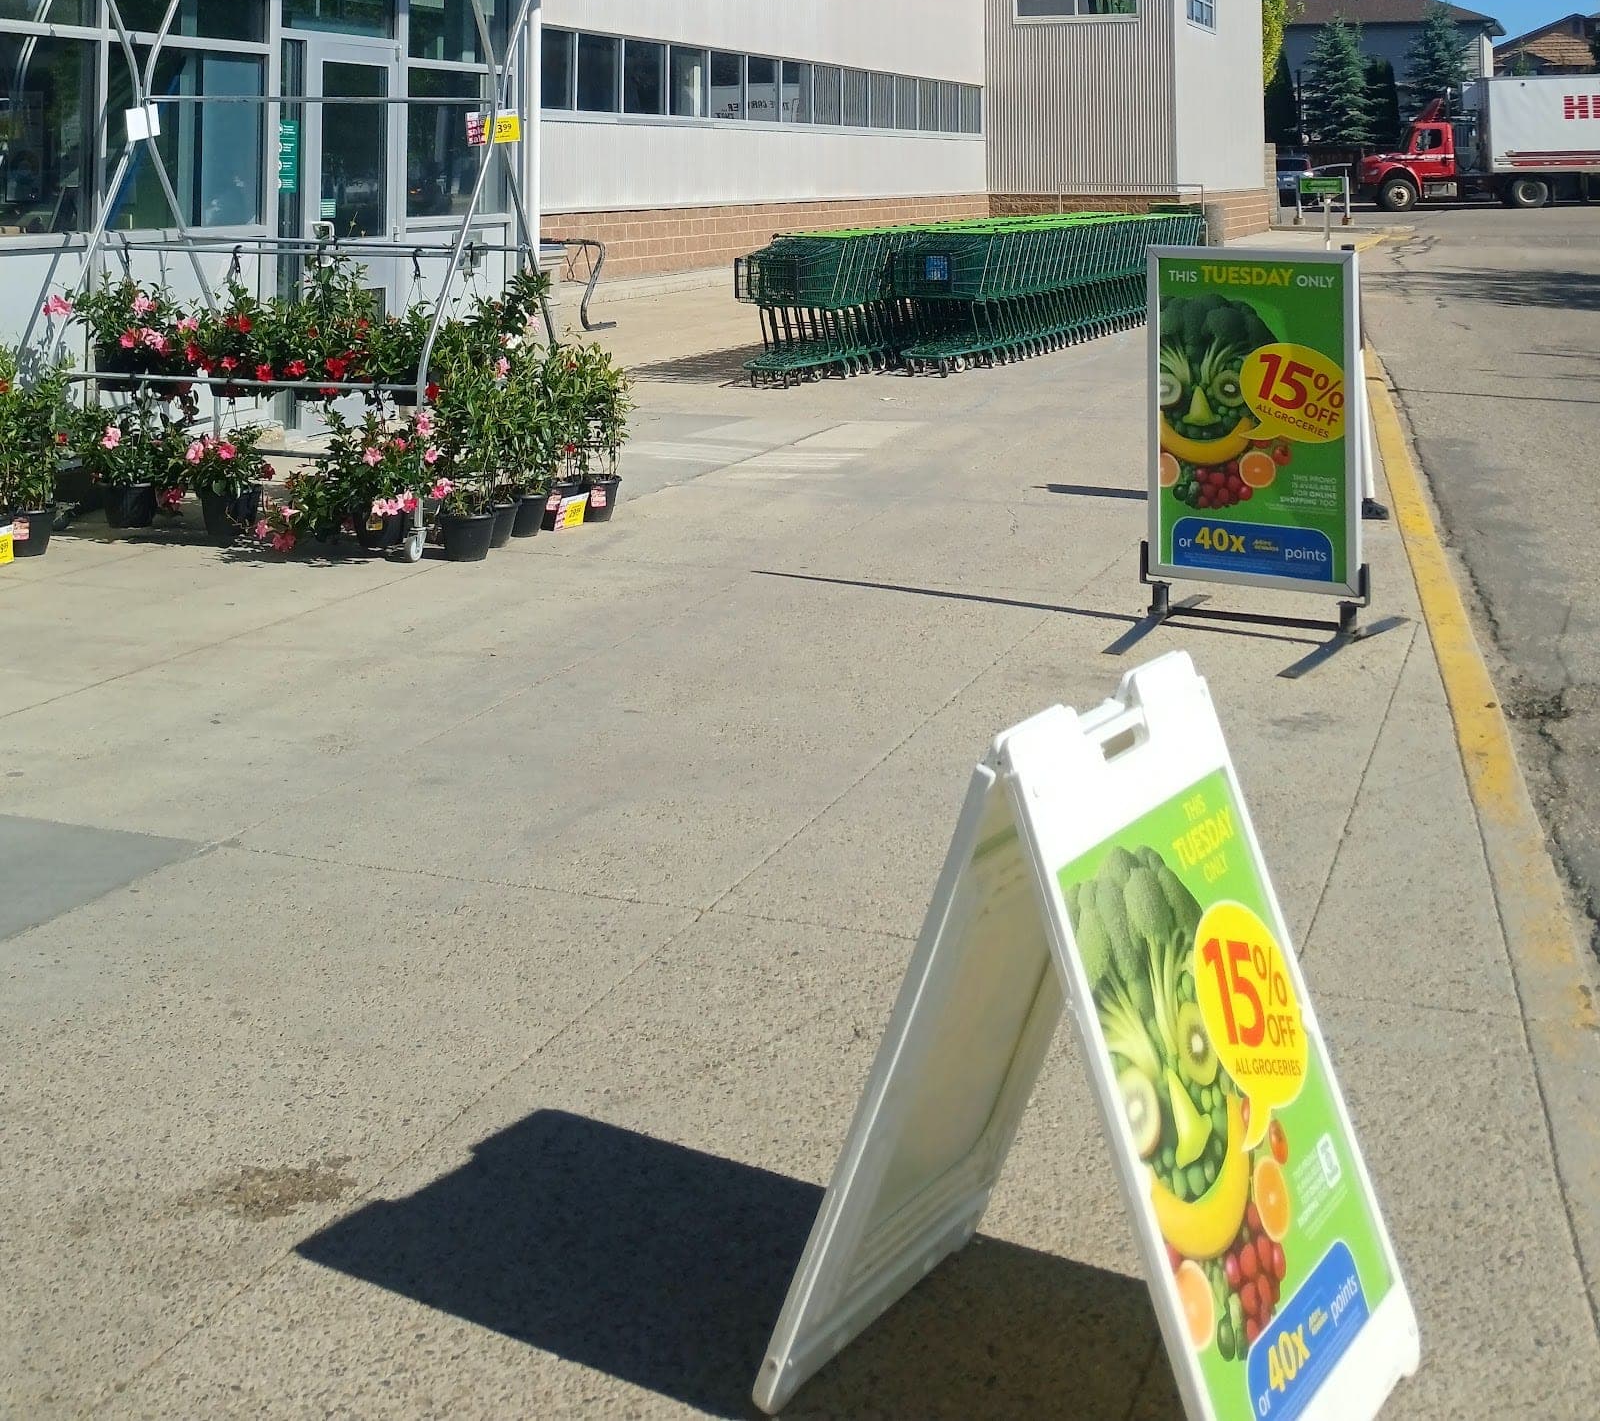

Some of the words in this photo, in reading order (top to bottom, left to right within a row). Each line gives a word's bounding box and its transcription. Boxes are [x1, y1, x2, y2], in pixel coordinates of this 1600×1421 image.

[1168, 270, 1198, 283] THIS
[1200, 265, 1294, 286] TUESDAY
[1296, 275, 1335, 288] ONLY
[1258, 353, 1344, 410] 15%
[1256, 404, 1272, 416] ALL
[1274, 410, 1329, 438] GROCERIES
[1304, 402, 1340, 426] OFF
[1178, 536, 1193, 548] or
[1195, 526, 1246, 554] 40x
[1284, 546, 1327, 562] points
[1182, 793, 1206, 822] THIS
[1172, 804, 1234, 871] TUESDAY
[1203, 851, 1228, 884] ONLY
[1202, 937, 1288, 1047] 15%
[1266, 1013, 1296, 1048] OFF
[1235, 1057, 1252, 1076] ALL
[1252, 1056, 1302, 1076] GROCERIES
[1258, 1388, 1271, 1417] or
[1268, 1323, 1311, 1393] 40x
[1329, 1275, 1359, 1328] points
